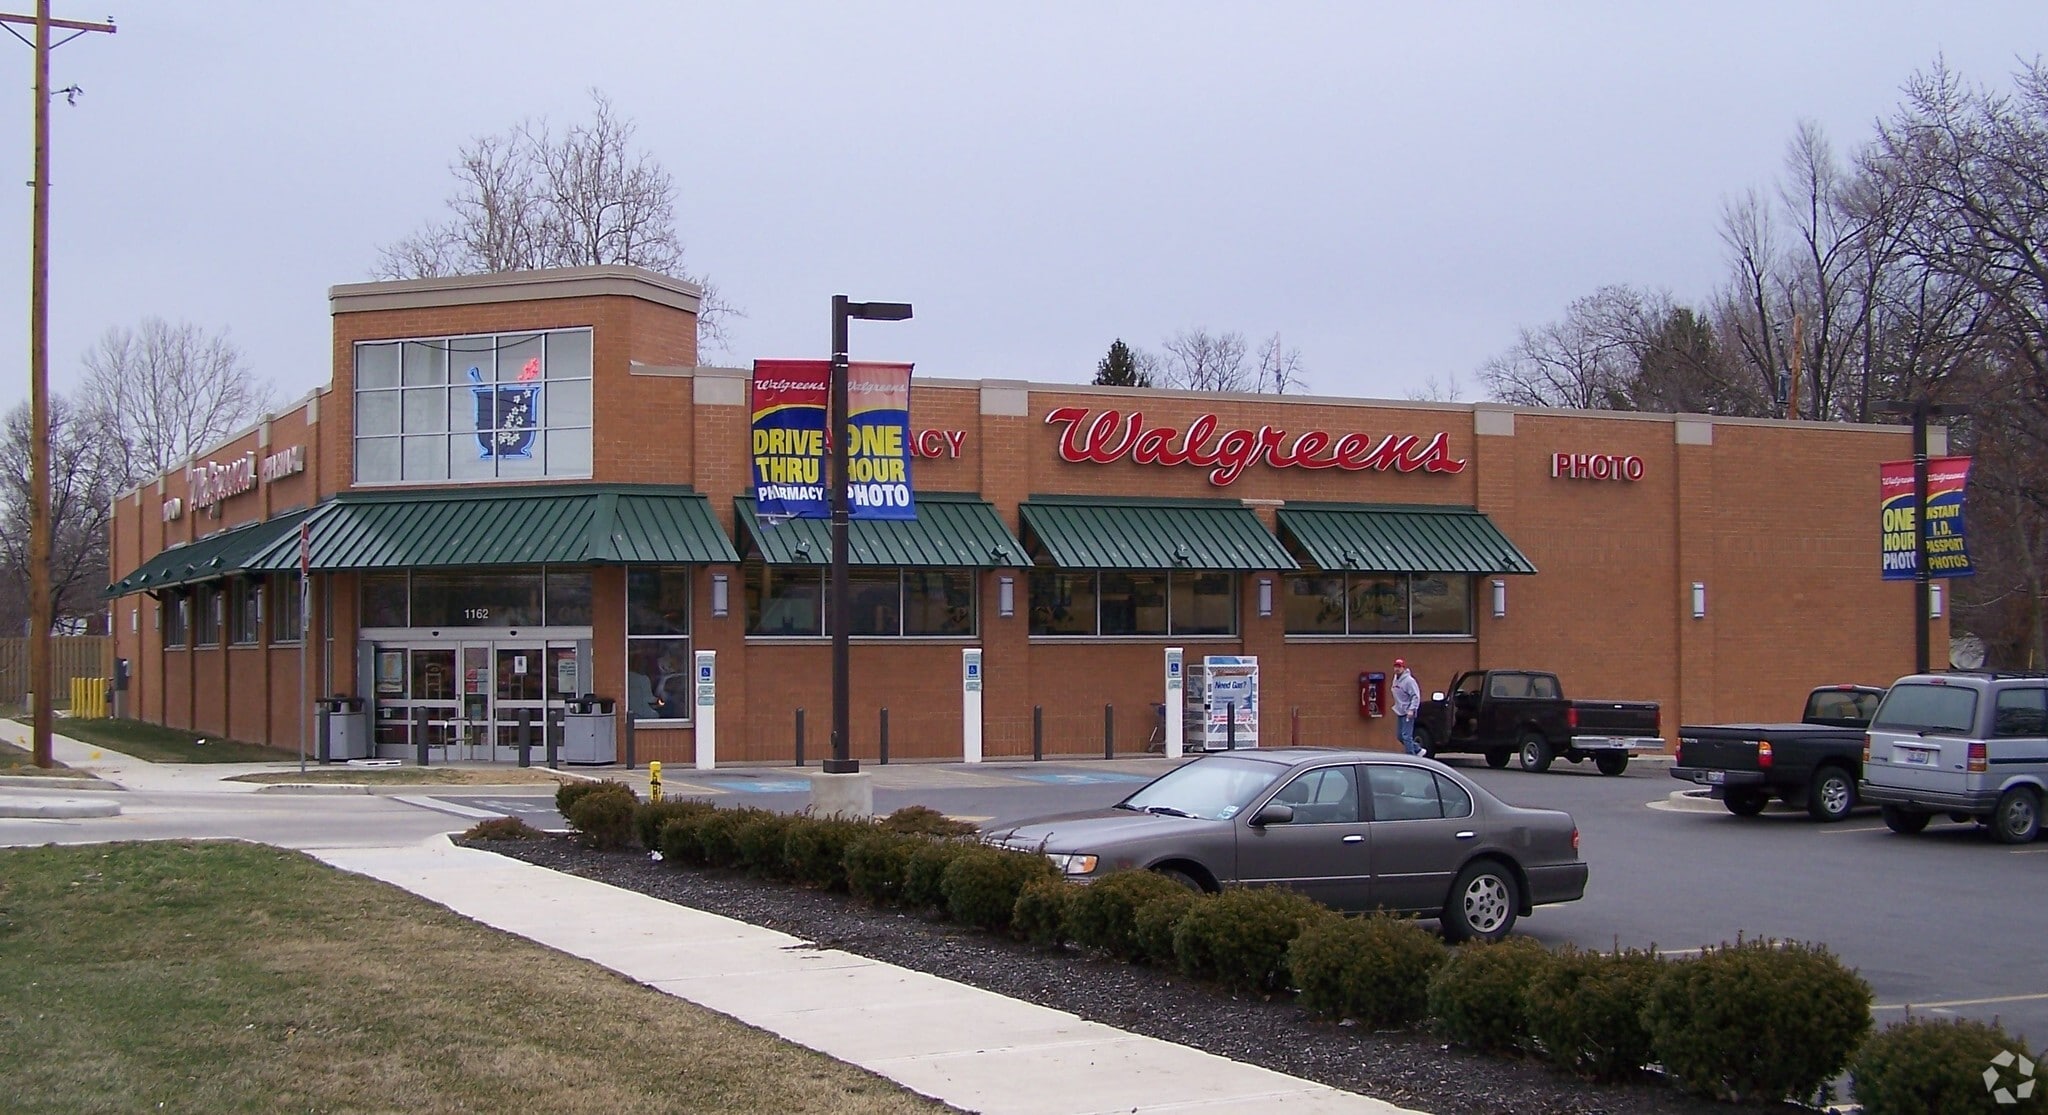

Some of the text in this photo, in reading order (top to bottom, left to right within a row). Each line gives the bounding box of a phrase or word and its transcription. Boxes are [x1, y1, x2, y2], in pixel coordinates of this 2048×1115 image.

[755, 379, 826, 393] Walgreens
[753, 428, 823, 456] DRIVE
[1045, 407, 1467, 488] Walgreens
[755, 456, 819, 484] THRU
[1552, 452, 1646, 482] PHOTO
[1883, 507, 1916, 532] ONE
[1926, 505, 1960, 519] NSTANT
[1928, 555, 1968, 569] PHOTOS
[464, 608, 489, 619] 1162
[1215, 681, 1231, 689] Need
